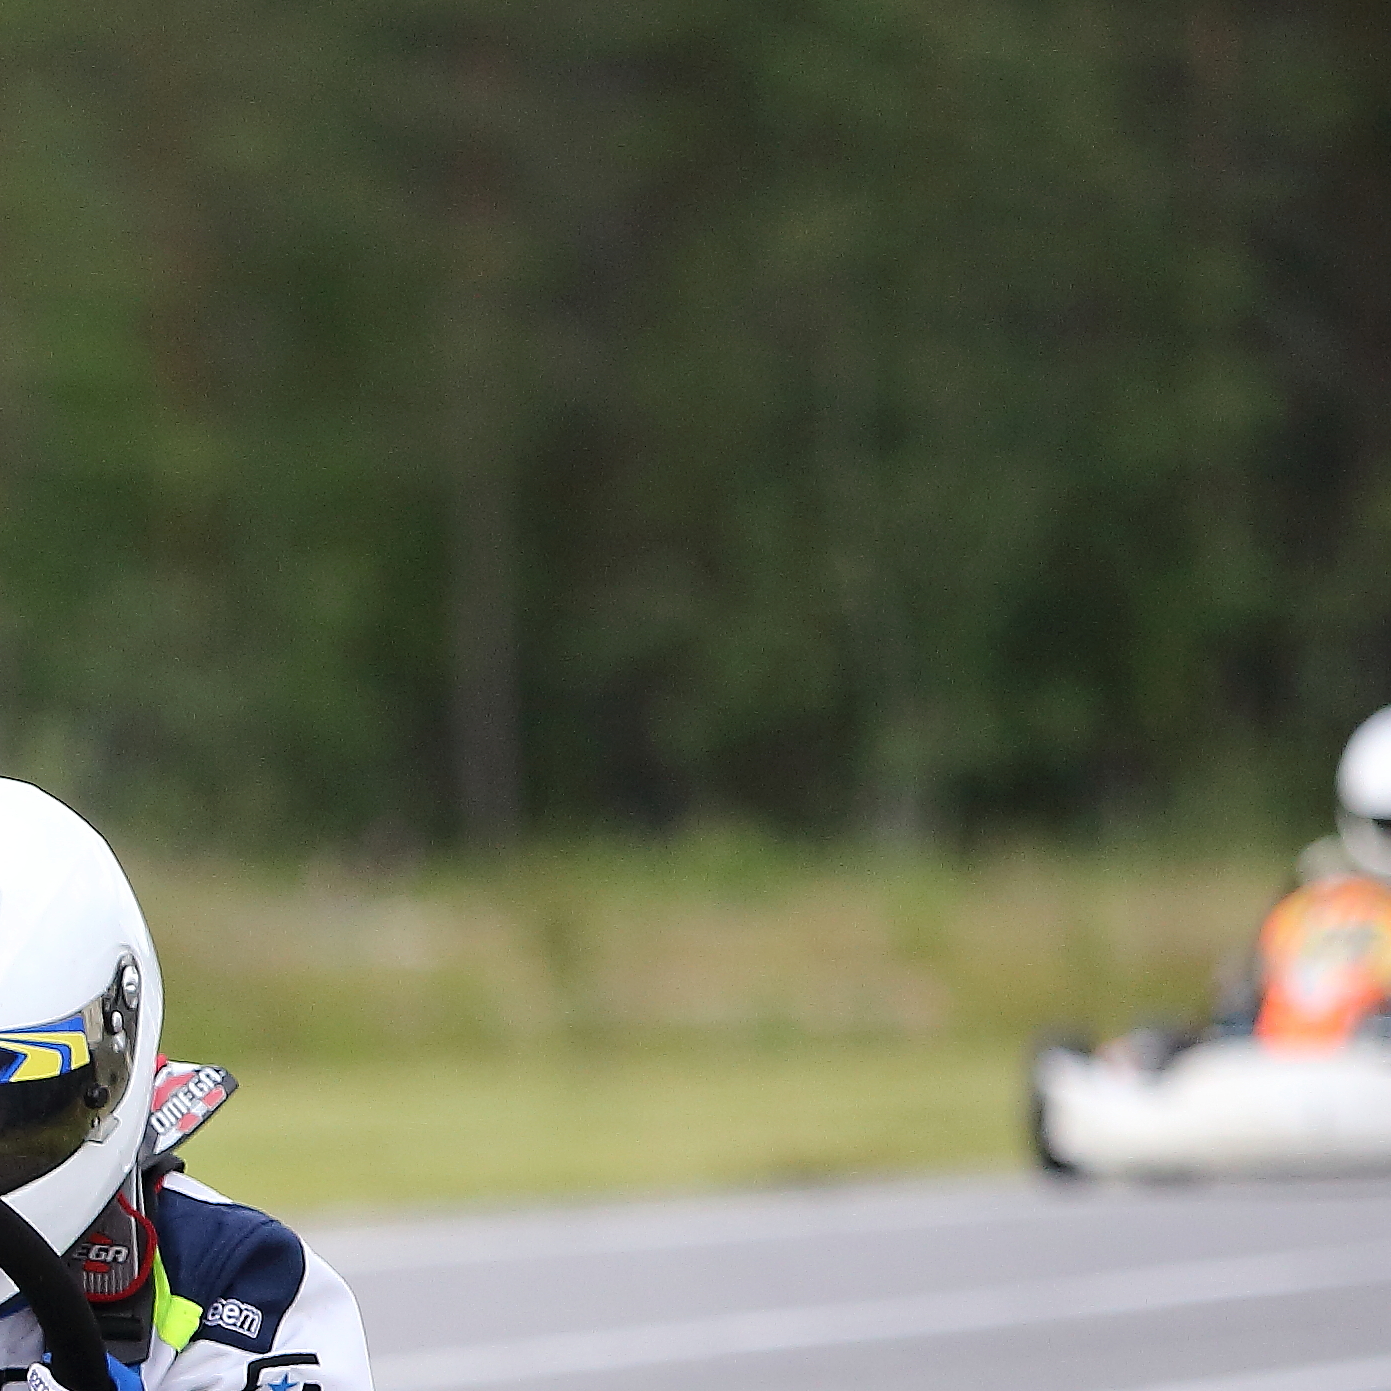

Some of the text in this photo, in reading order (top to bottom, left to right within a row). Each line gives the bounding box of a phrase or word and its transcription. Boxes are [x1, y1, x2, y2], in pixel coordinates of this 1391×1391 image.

[150, 1067, 225, 1135] OMEGA
[72, 1243, 129, 1262] EGA
[205, 1298, 262, 1338] eem
